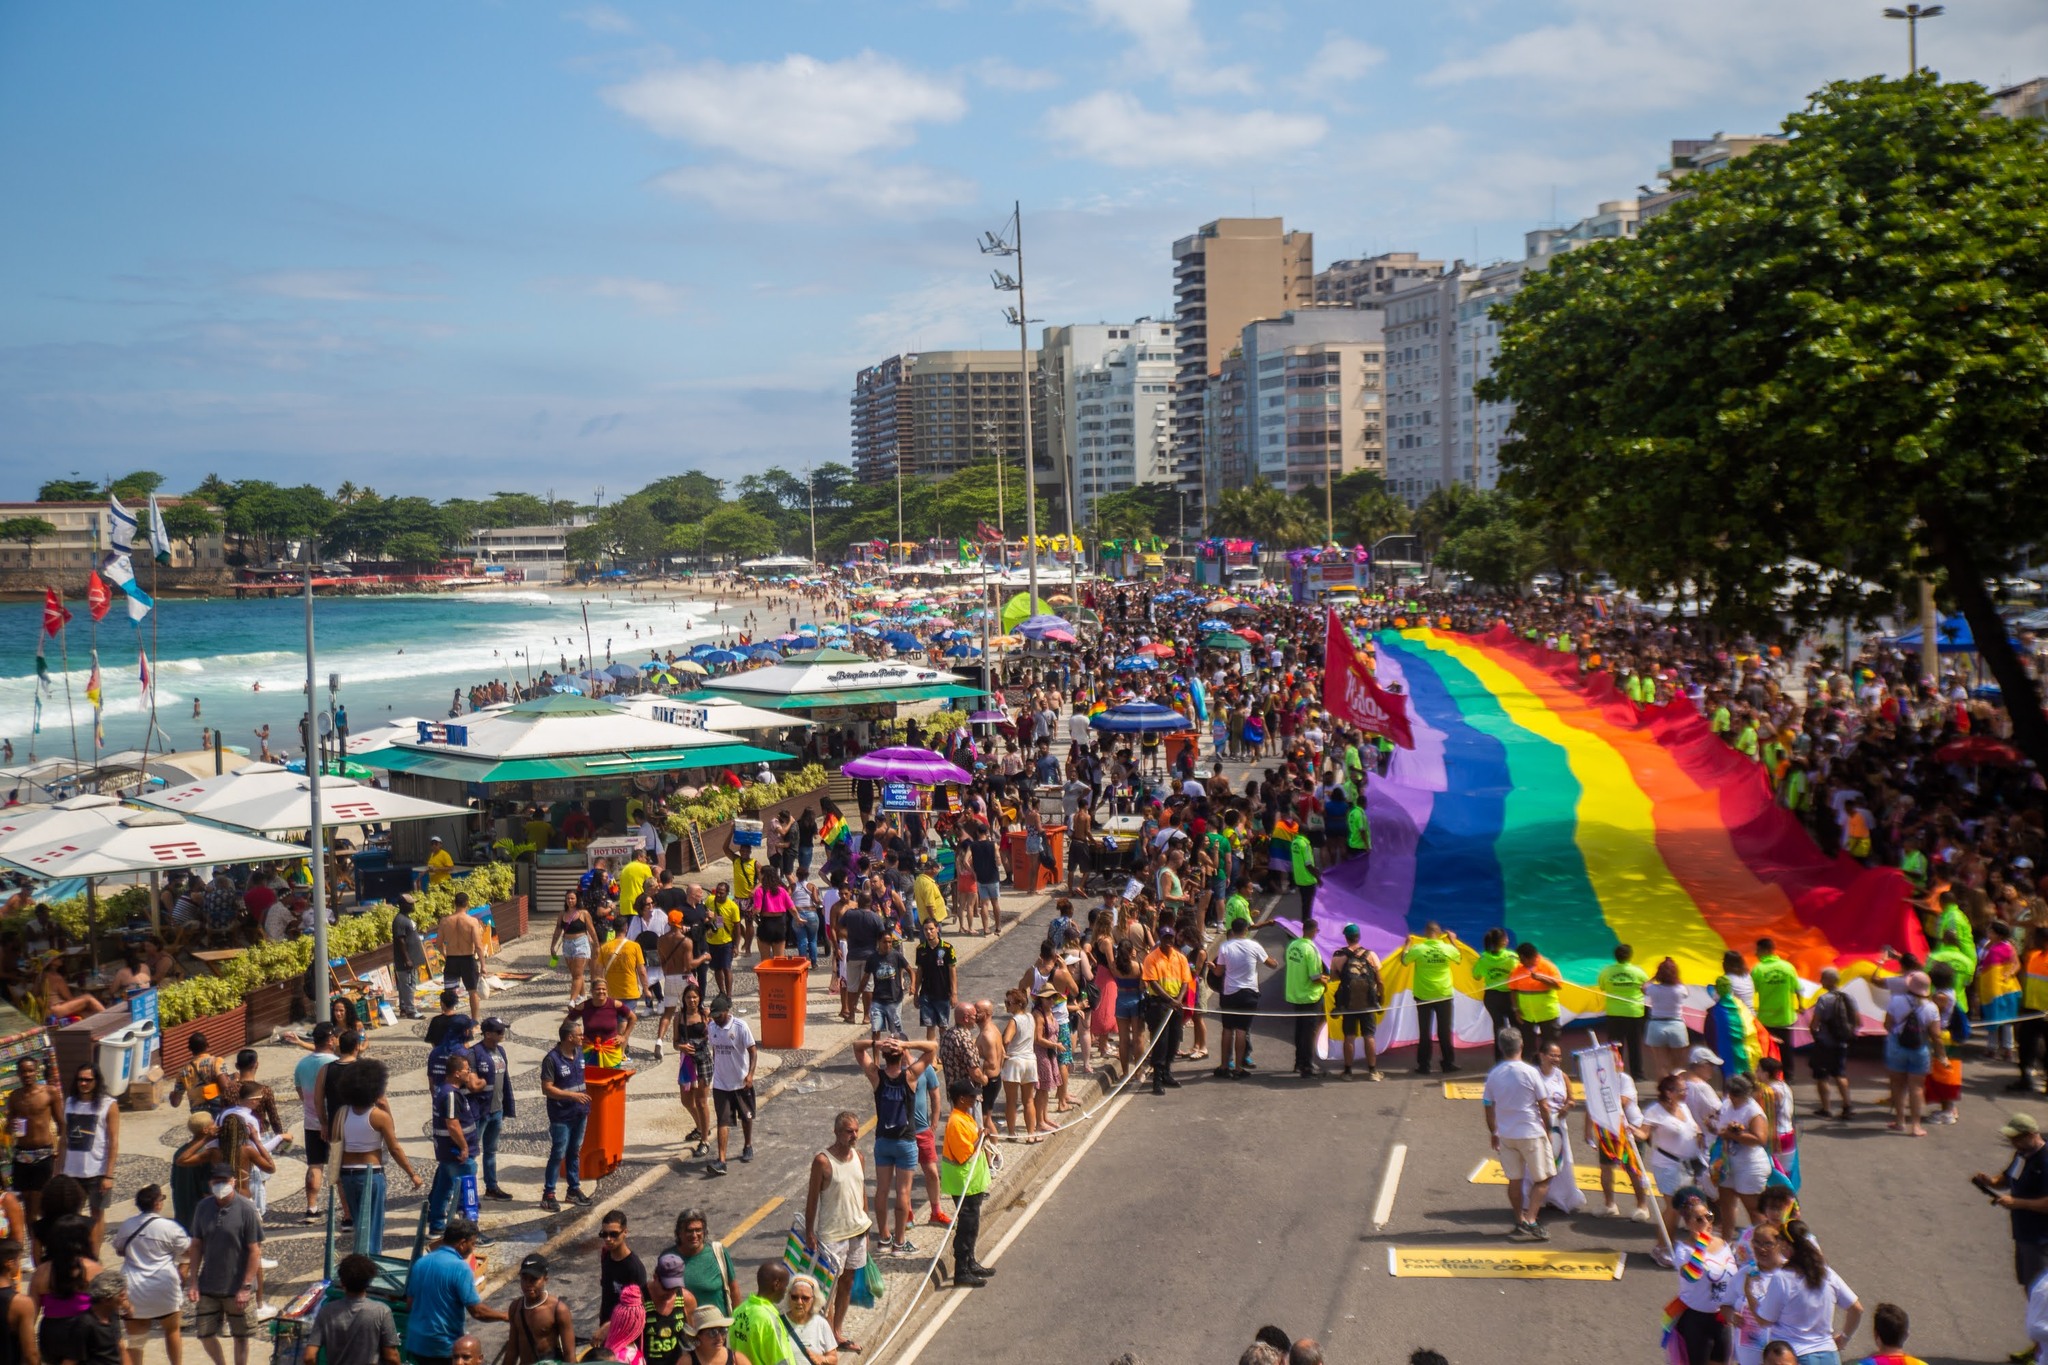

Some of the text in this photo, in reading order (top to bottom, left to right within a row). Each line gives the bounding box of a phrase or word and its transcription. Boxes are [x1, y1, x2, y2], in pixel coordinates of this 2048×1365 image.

[594, 848, 609, 856] HOT
[1441, 1257, 1495, 1265] todas
[1493, 1264, 1616, 1272] CORAGEM
